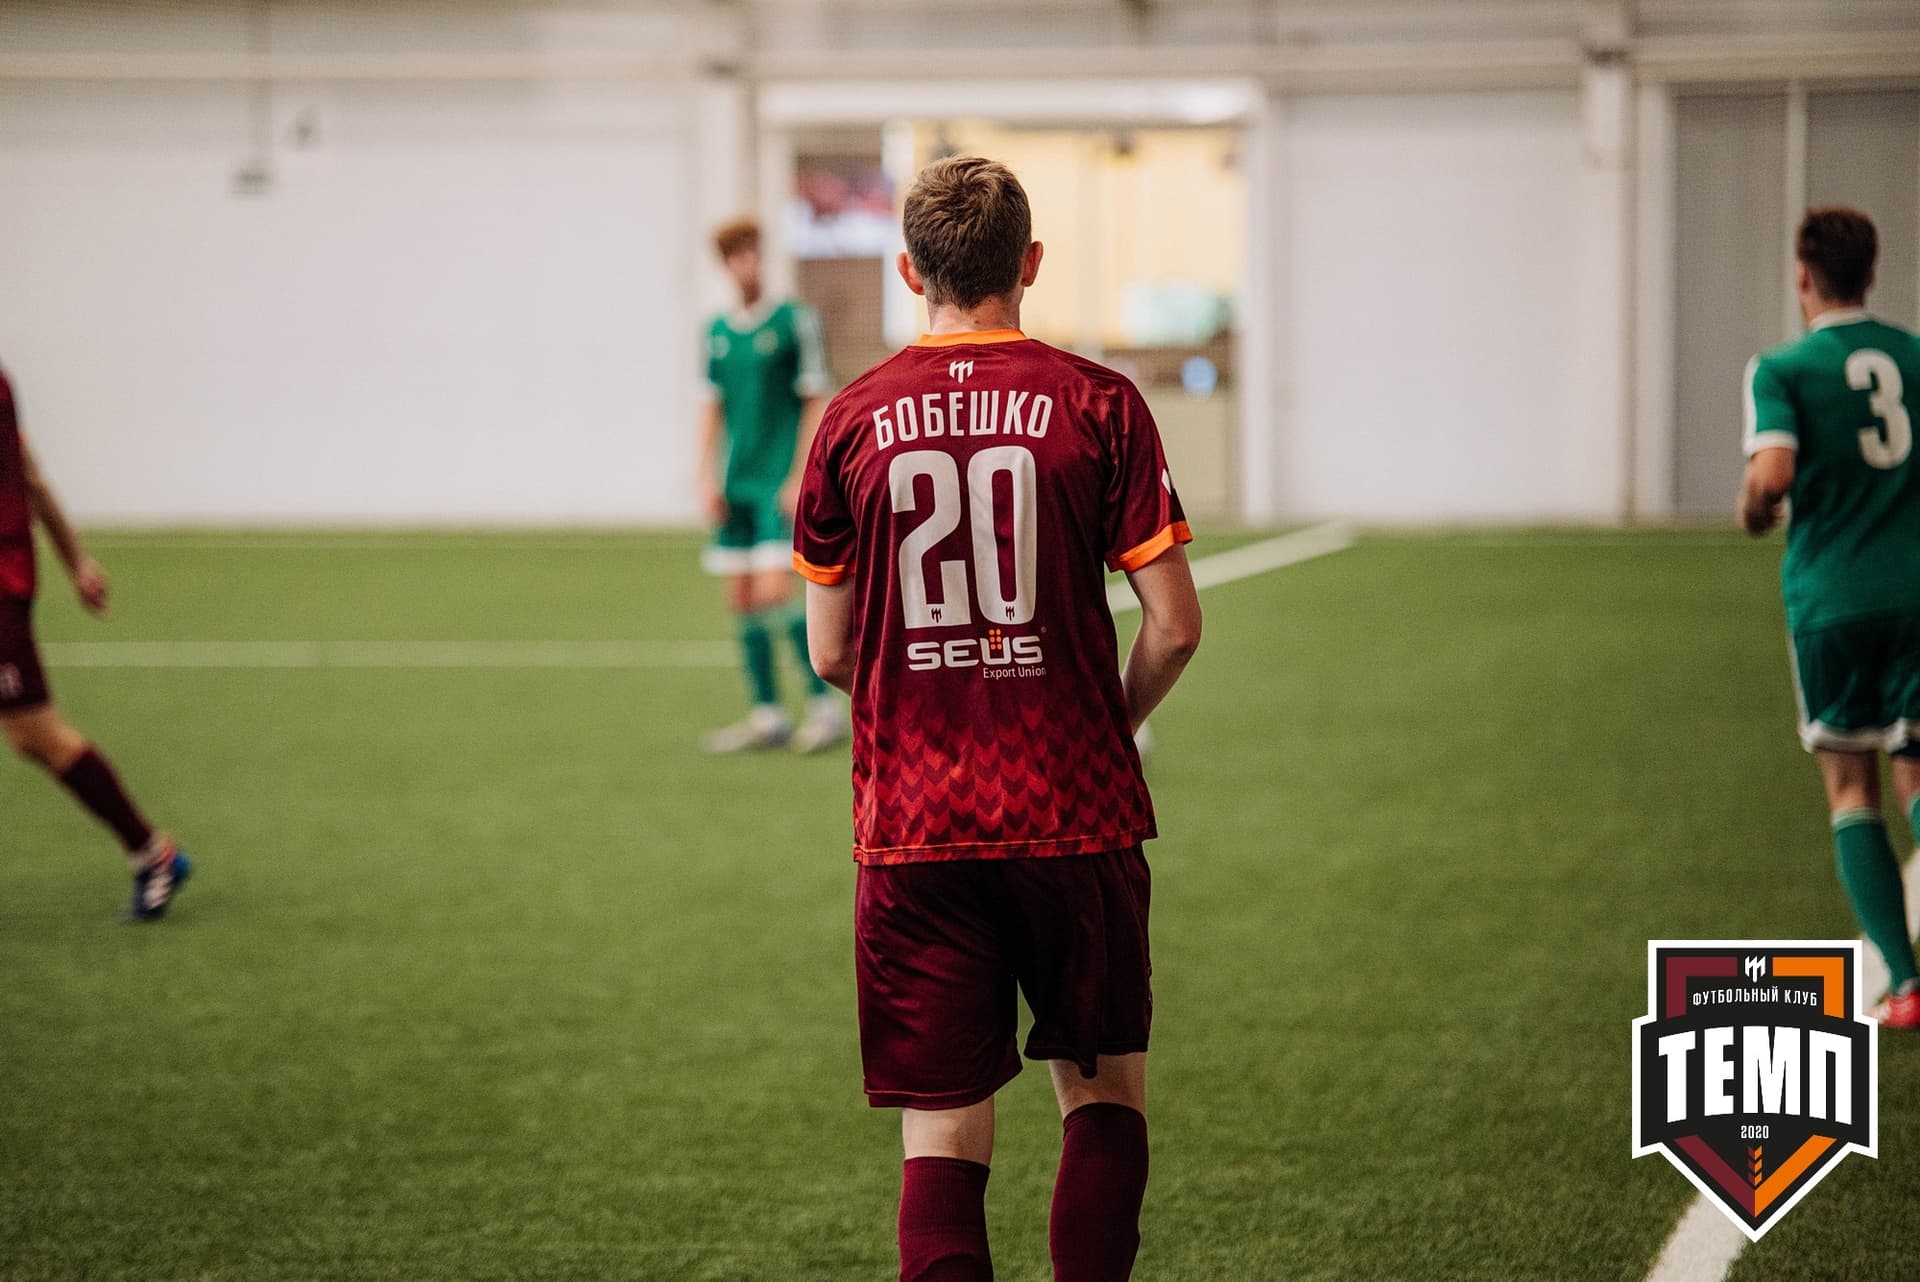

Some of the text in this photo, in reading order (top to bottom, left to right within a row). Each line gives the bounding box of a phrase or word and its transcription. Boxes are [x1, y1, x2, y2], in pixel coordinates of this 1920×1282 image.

[872, 390, 1053, 451] БОБЕШКО
[1845, 348, 1912, 470] 3
[888, 446, 1037, 629] 20
[983, 665, 1047, 680] Export Union
